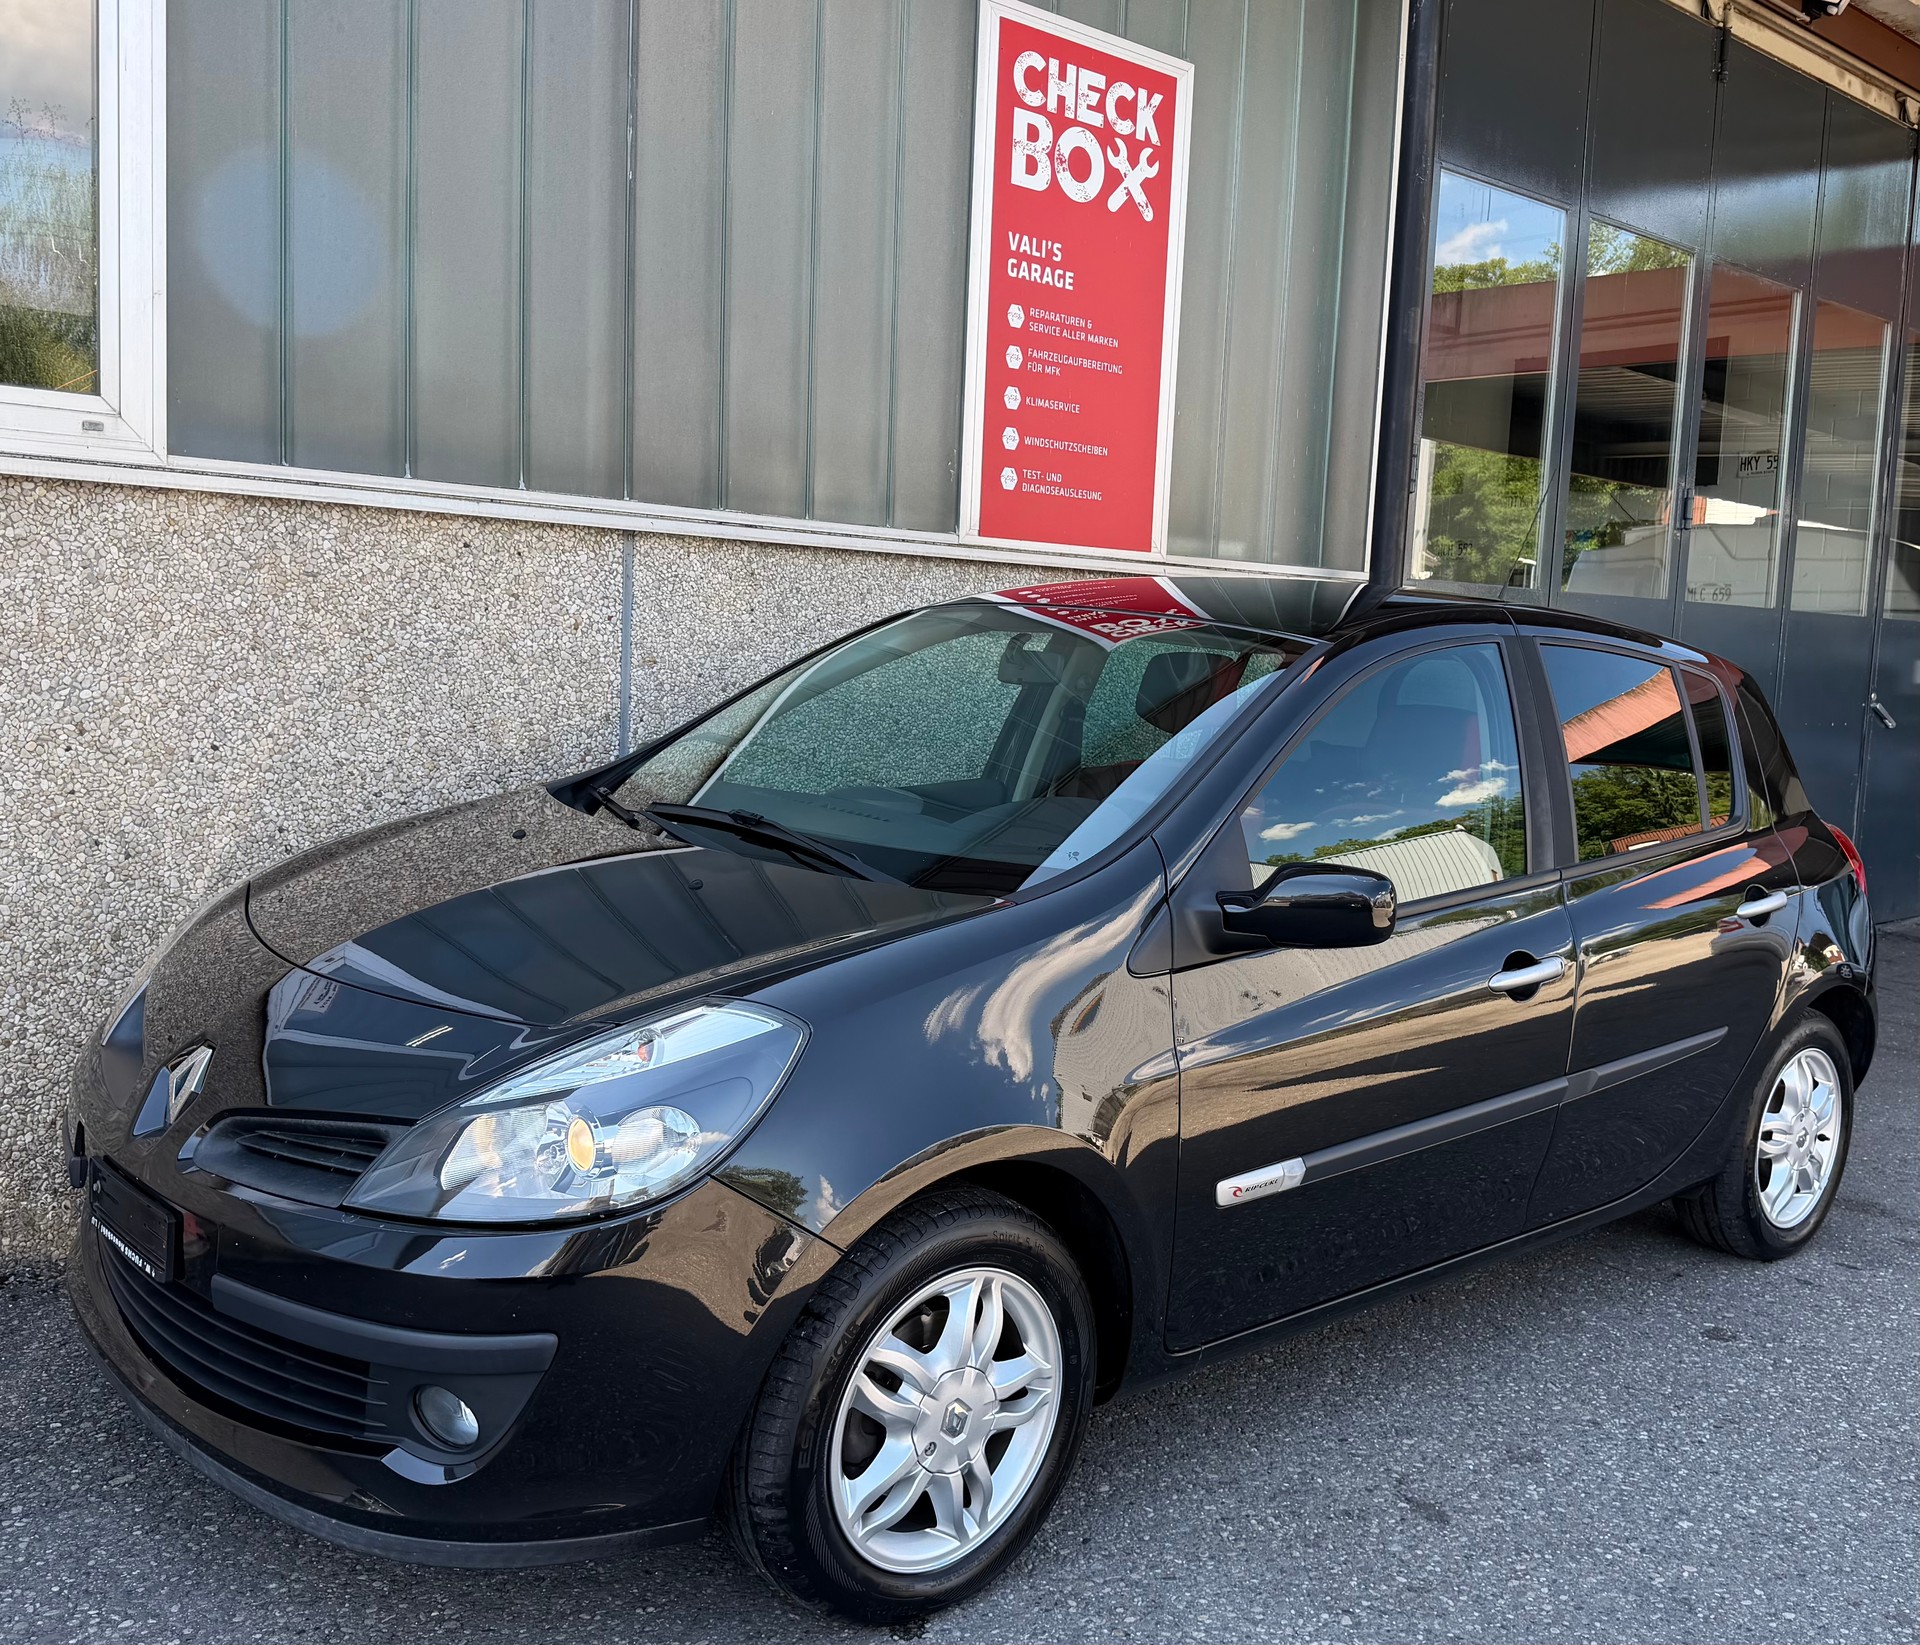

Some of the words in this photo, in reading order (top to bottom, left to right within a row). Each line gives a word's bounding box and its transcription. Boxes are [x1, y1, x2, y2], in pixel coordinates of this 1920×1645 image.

[1013, 50, 1164, 147] CHECK
[1010, 106, 1160, 222] BOX
[1008, 231, 1062, 262] VALI'S
[1007, 258, 1074, 290] GARAGE
[1029, 307, 1086, 328] REPARATUREN
[1087, 319, 1093, 329] &
[1029, 322, 1060, 337] SERVICE
[1062, 328, 1086, 342] ALLER
[1087, 334, 1119, 348] MARKEN
[1027, 348, 1123, 375] FAHRZEUGAUFBEREITUNG
[1027, 361, 1043, 374] FÜR
[1044, 364, 1061, 377] MFK
[1025, 396, 1080, 414] KLIMASERVICE
[1024, 436, 1108, 456] WINDSCHUTZSCHEIBEN
[1740, 456, 1760, 471] HKY
[1022, 469, 1045, 480] TEST-
[1046, 472, 1062, 483] UND
[1022, 482, 1102, 501] DIAGNOSEAUSLESUNG
